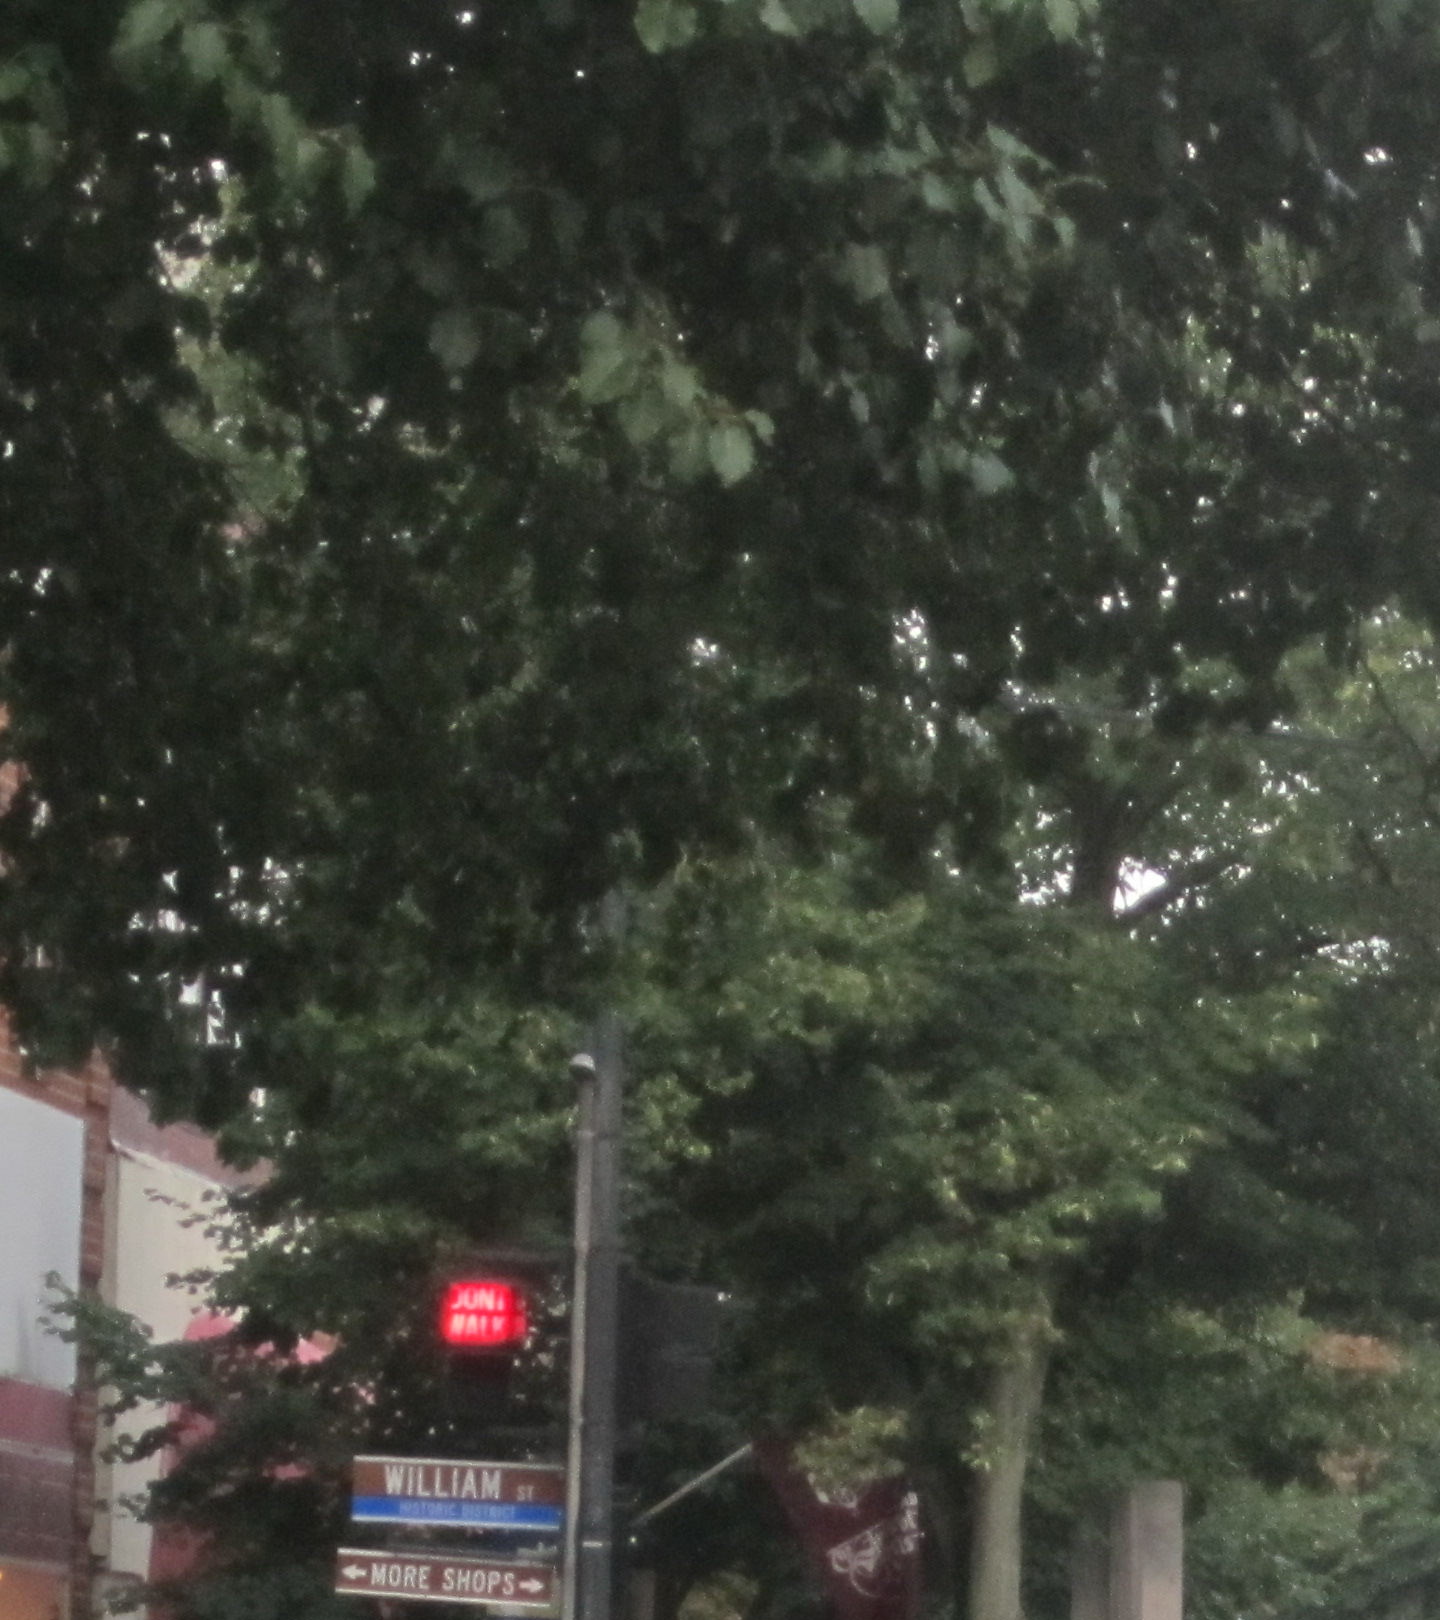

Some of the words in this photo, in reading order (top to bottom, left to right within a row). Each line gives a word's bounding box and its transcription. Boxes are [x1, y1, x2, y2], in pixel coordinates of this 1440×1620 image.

[384, 1464, 501, 1500] WILLIAM
[517, 1485, 534, 1501] ST
[371, 1562, 431, 1590] MORE
[443, 1568, 515, 1596] SHOPS
